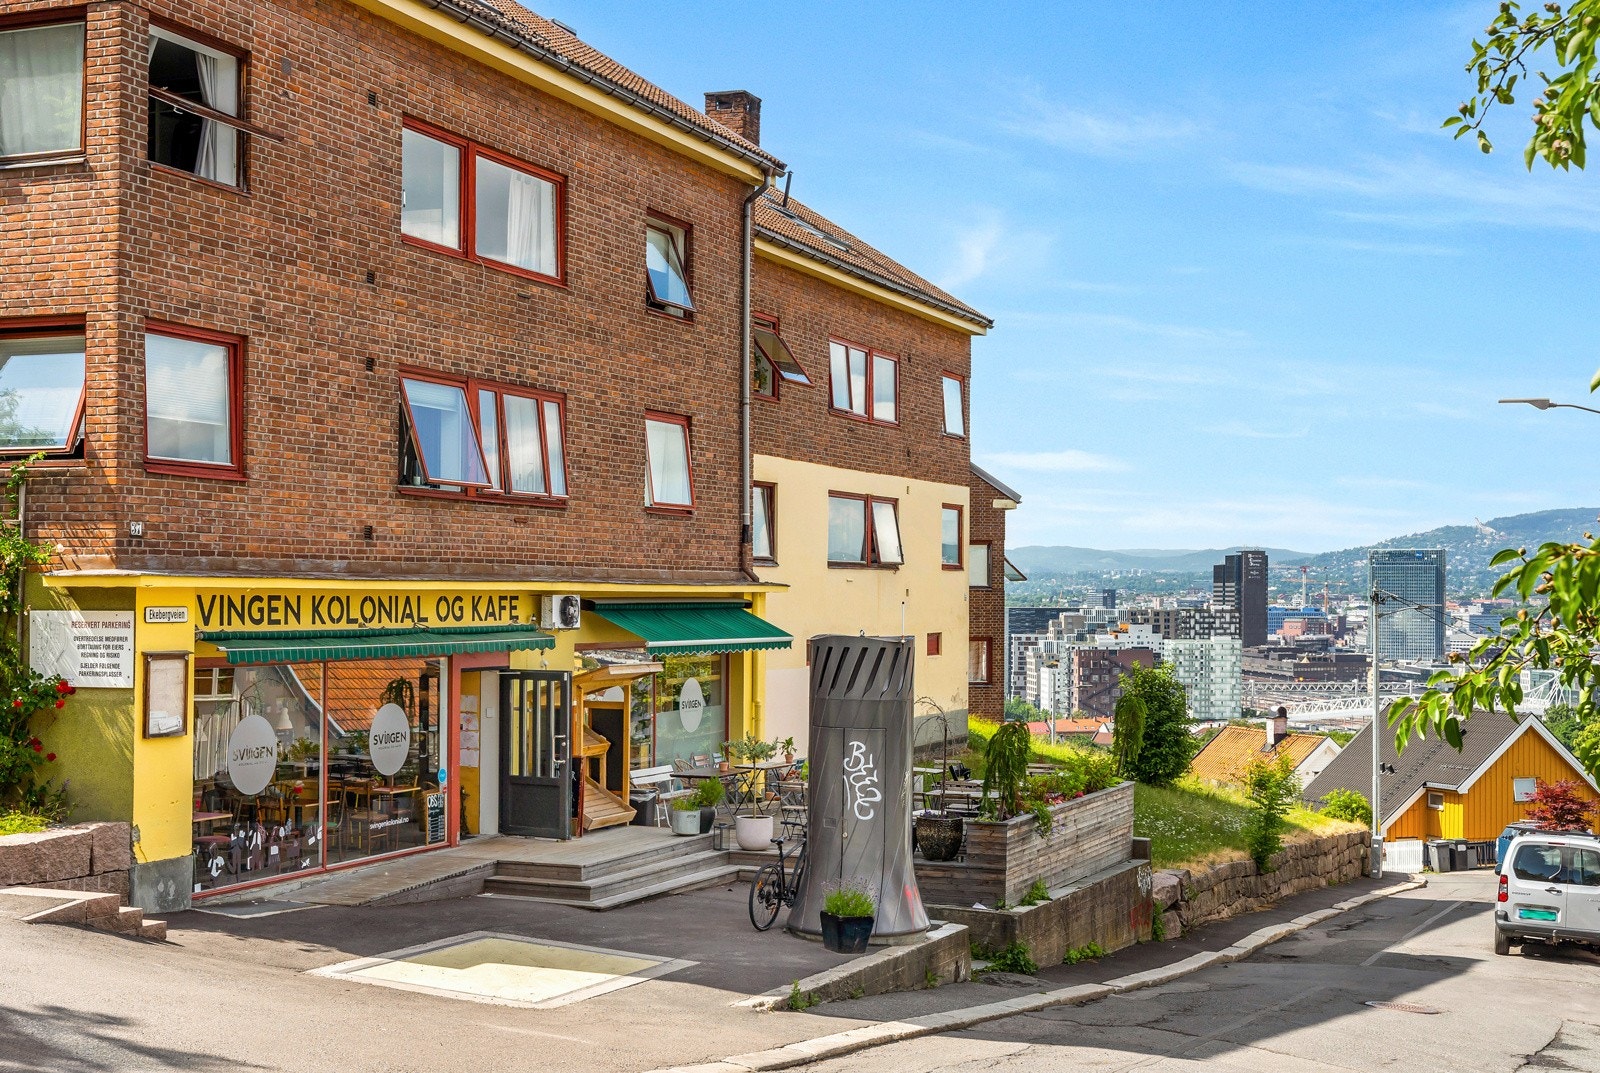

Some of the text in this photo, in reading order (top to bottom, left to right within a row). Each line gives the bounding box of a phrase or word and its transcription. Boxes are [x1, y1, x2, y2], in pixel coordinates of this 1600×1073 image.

[149, 609, 186, 621] Ekebergveien
[197, 594, 519, 626] VINGEN KOLONIAL OG KAFE
[71, 621, 131, 629] RESERVERT PARKERING
